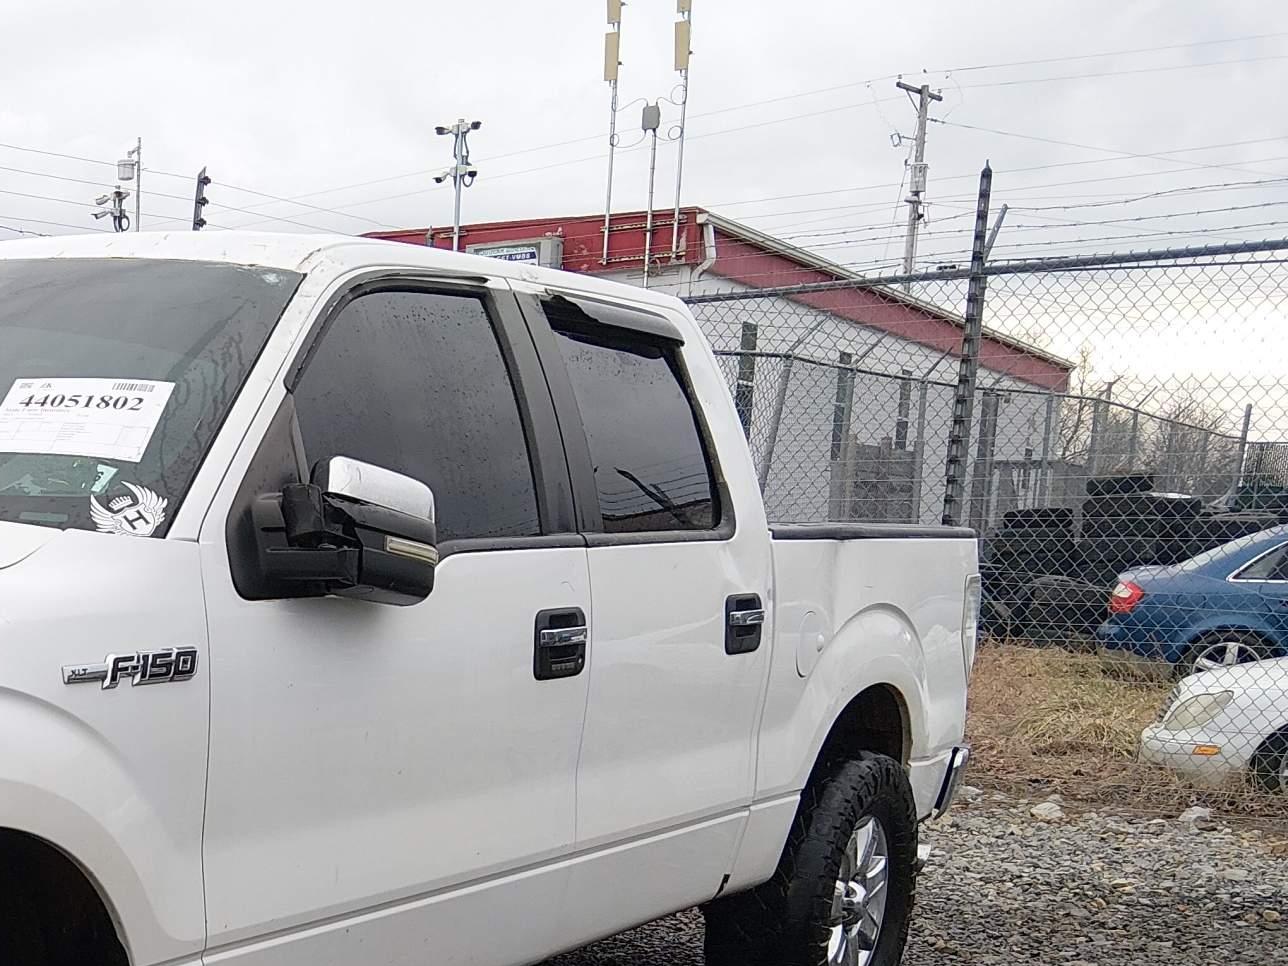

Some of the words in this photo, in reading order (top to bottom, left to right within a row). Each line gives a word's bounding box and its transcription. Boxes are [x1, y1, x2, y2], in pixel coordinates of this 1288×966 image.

[18, 393, 145, 411] 44051802
[71, 668, 88, 677] XLT
[102, 646, 198, 690] F-150
